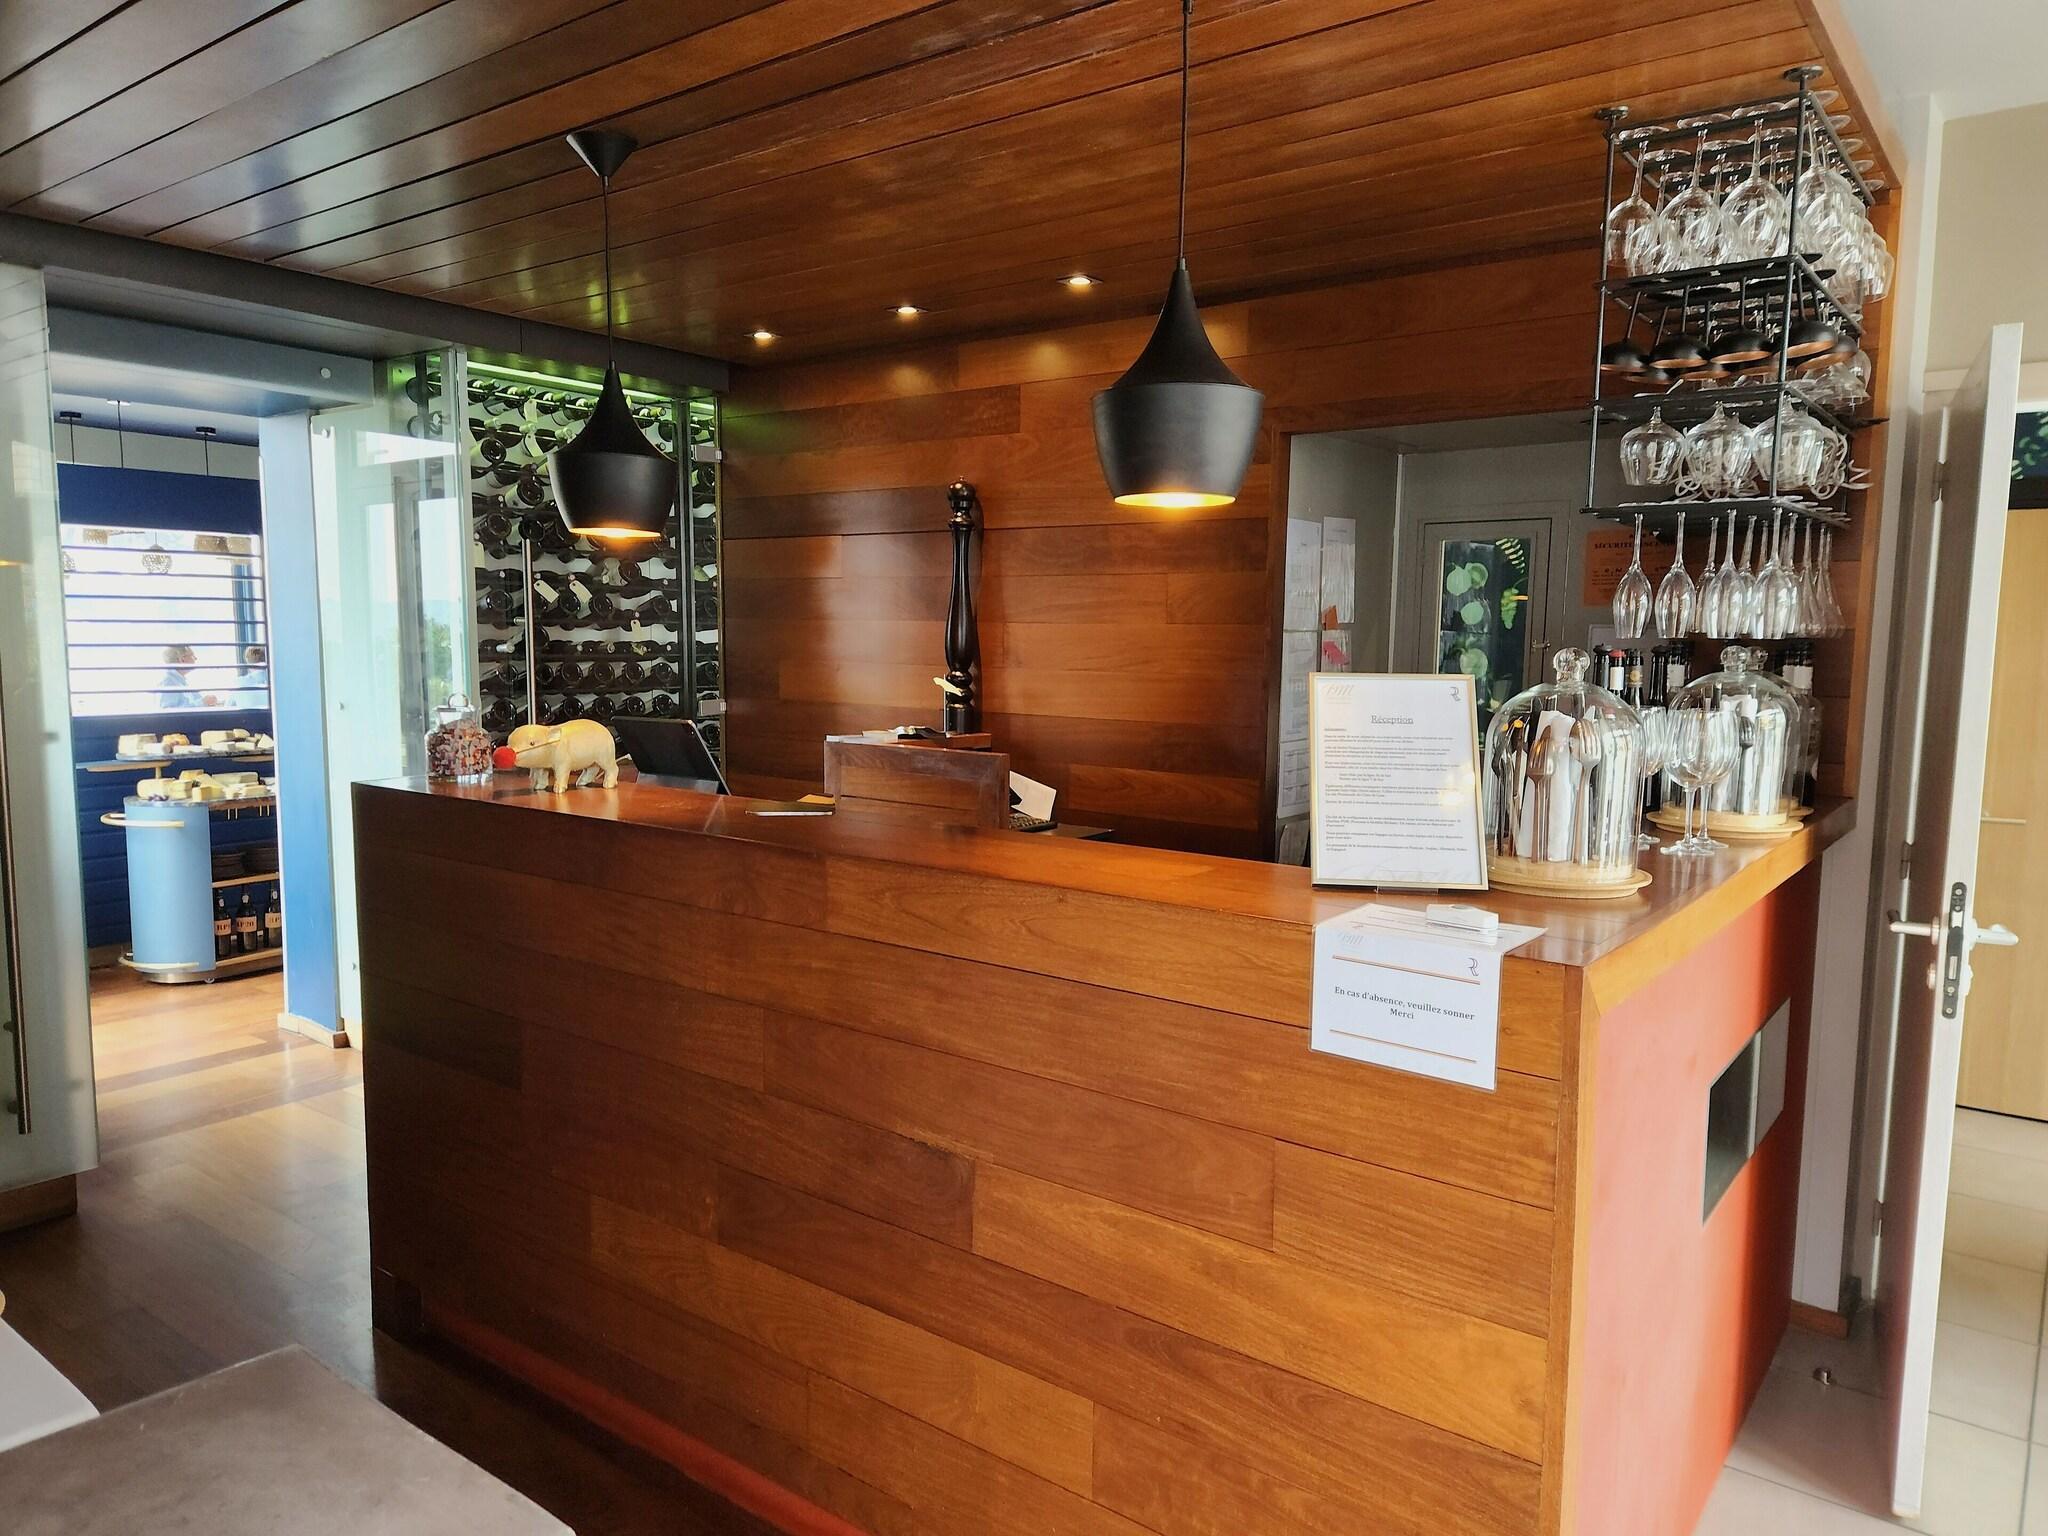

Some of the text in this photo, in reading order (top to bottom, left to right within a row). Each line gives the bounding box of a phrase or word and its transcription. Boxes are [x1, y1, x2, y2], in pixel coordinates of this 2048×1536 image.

[1371, 715, 1414, 725] Réception
[1334, 986, 1475, 1021] En cas d'absence, veuillez sonner
[1390, 1007, 1415, 1020] Merci
